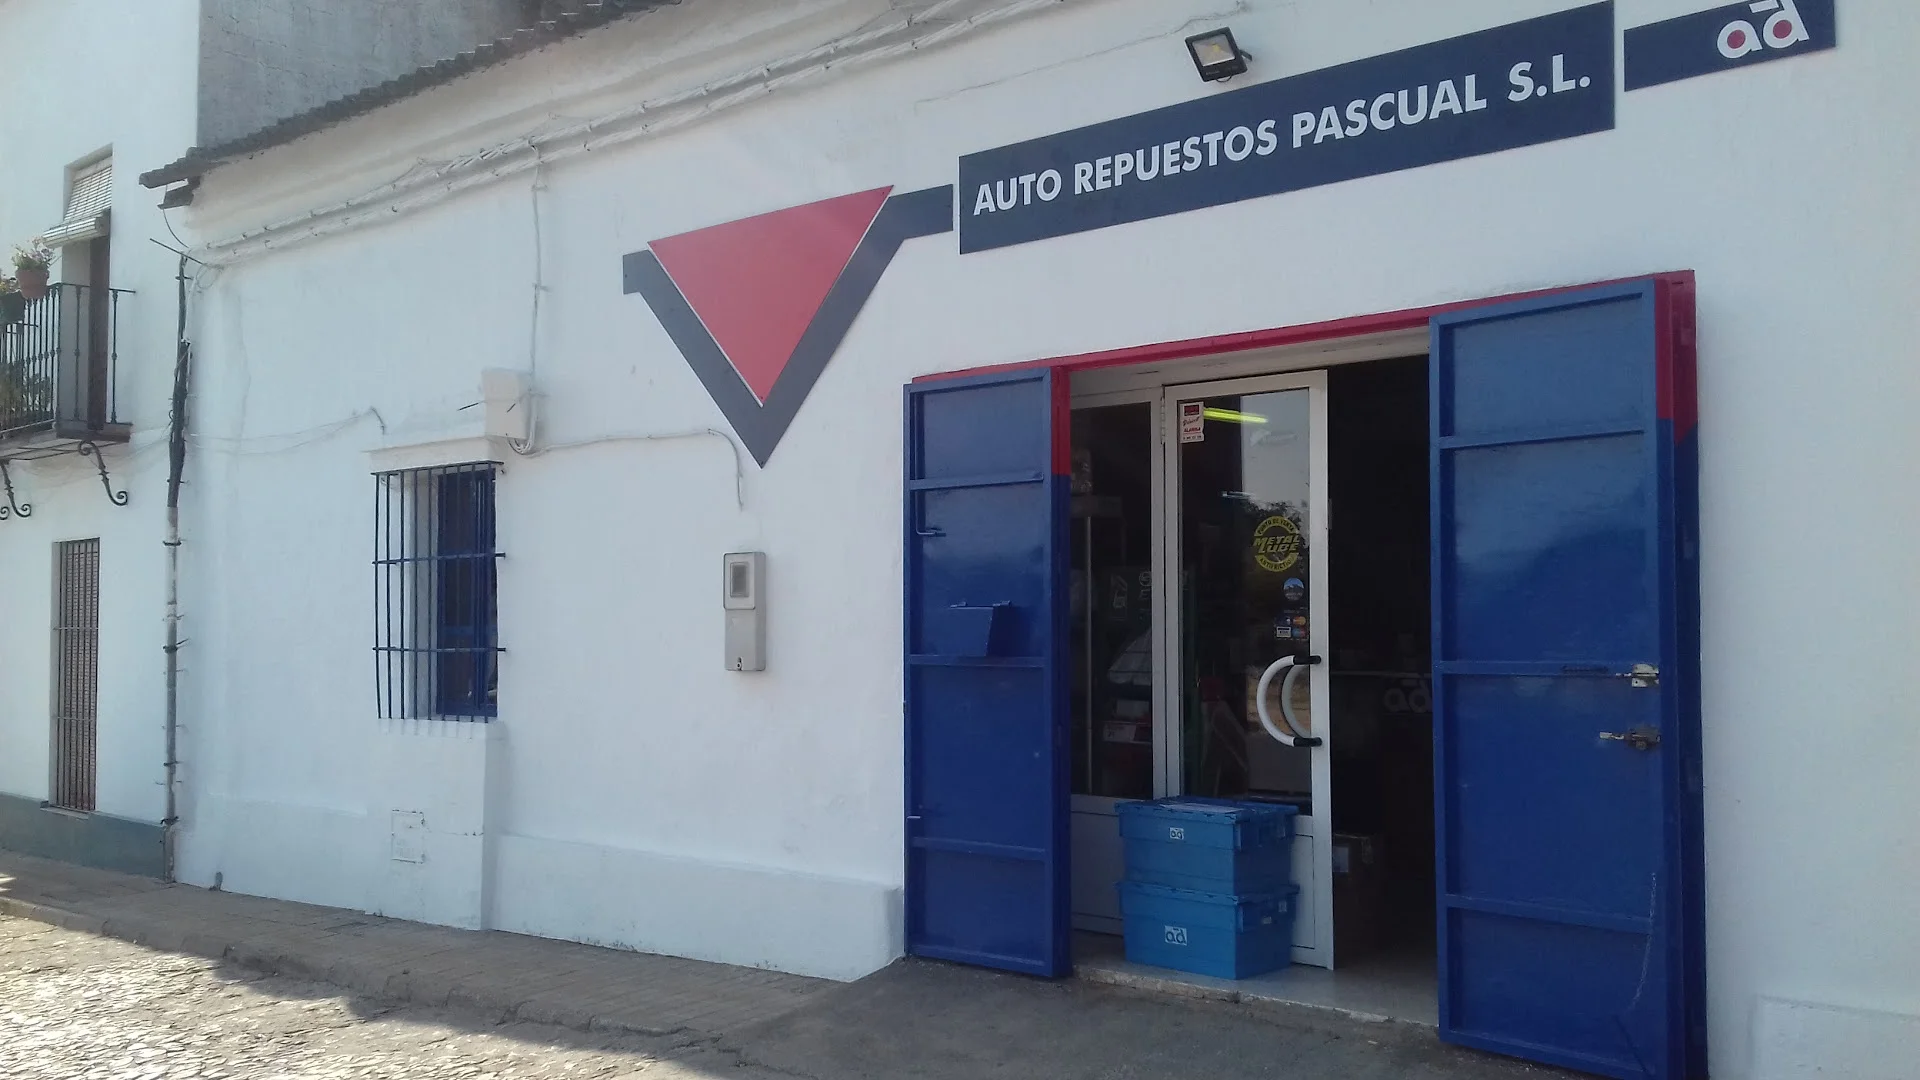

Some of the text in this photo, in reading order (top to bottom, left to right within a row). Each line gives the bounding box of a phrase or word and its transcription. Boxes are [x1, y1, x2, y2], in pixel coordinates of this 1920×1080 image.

[973, 53, 1591, 216] AUTO REPUESTOS PASCUAL S.L.
[1253, 534, 1300, 546] METAL
